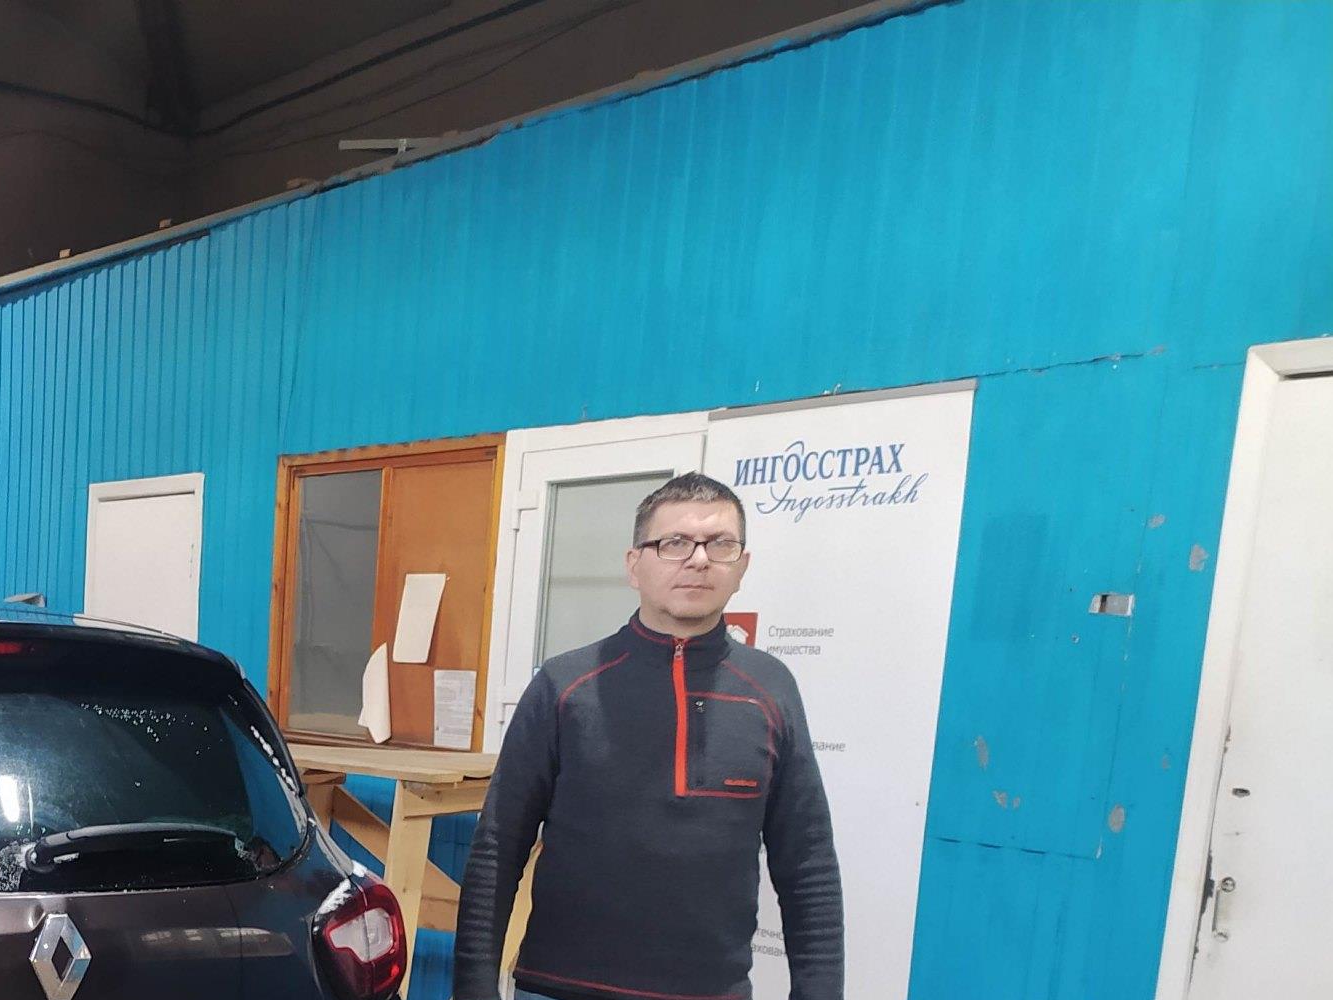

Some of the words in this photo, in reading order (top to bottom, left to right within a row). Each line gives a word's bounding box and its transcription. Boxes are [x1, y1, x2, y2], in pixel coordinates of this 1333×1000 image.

[733, 441, 905, 487] ИНГОССТРАХ
[755, 473, 929, 523] Ingosstrakh
[768, 625, 835, 639] Страхование
[812, 741, 846, 752] вание
